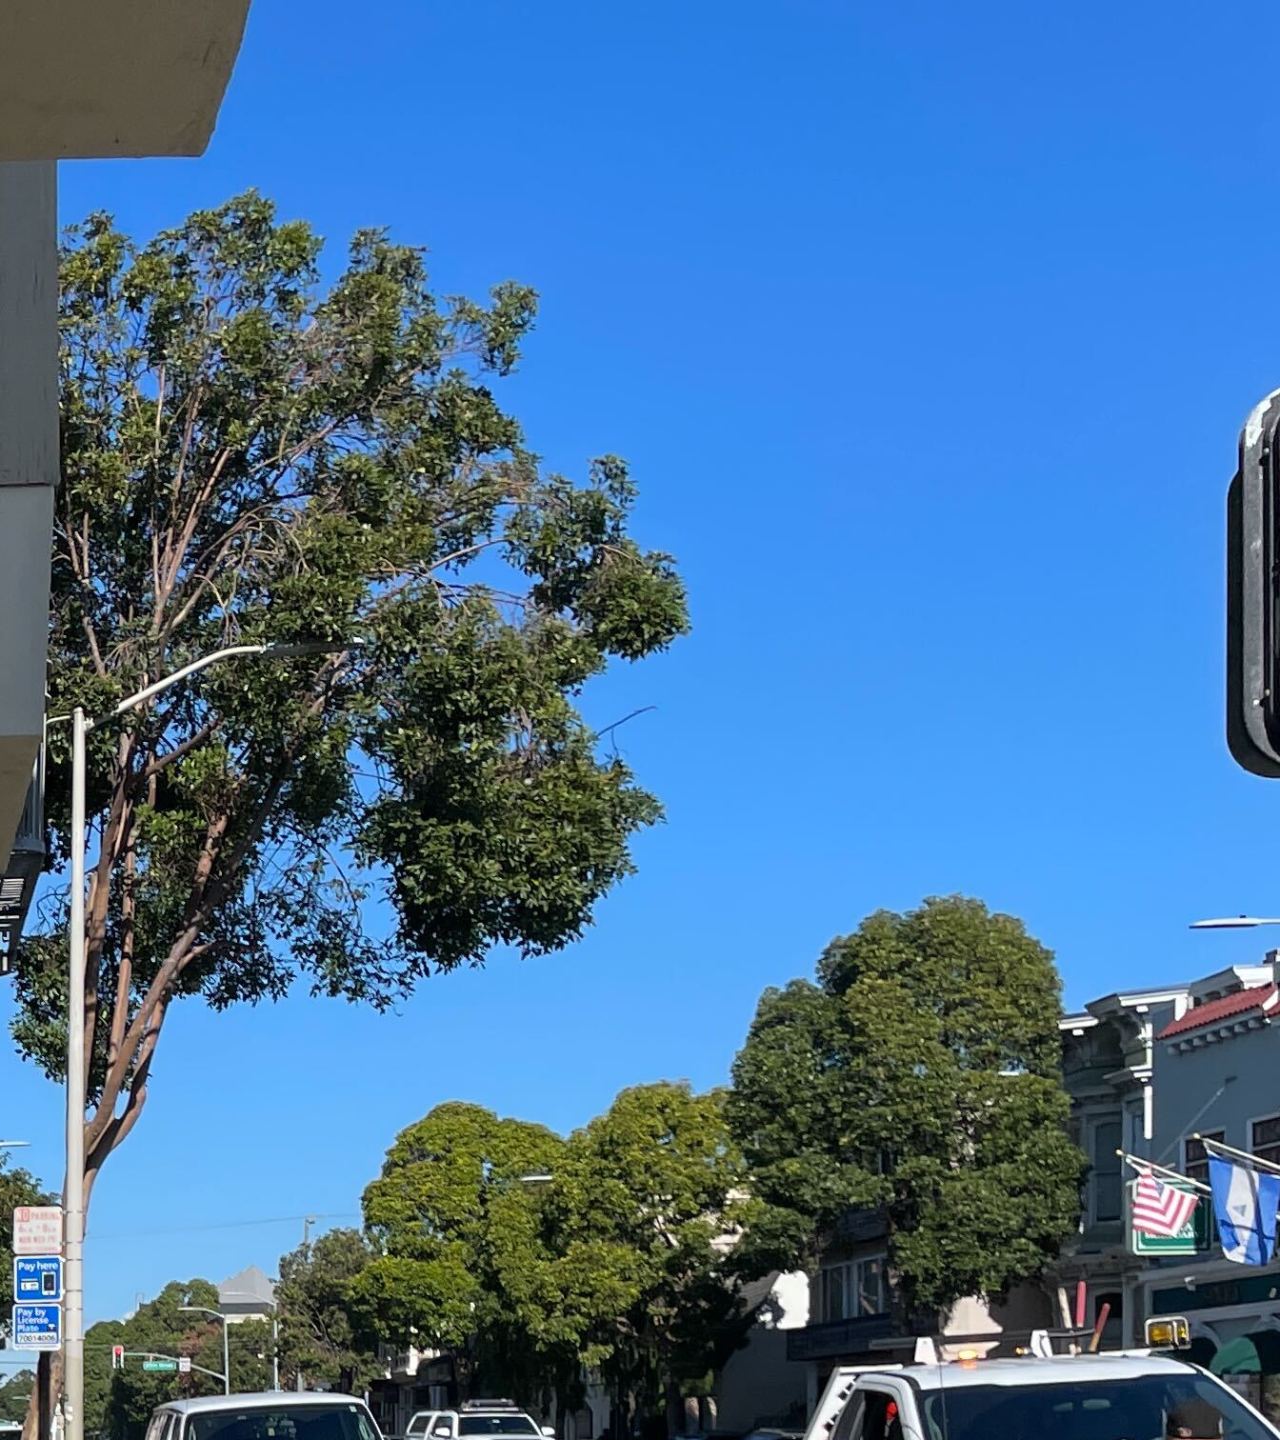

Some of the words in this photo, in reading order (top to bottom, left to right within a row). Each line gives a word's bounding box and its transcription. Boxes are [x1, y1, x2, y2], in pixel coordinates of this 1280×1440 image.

[18, 1261, 35, 1272] Pay
[37, 1261, 58, 1270] here
[17, 1308, 33, 1318] Pay
[35, 1307, 47, 1318] by
[17, 1316, 49, 1324] License
[17, 1324, 39, 1332] Plate
